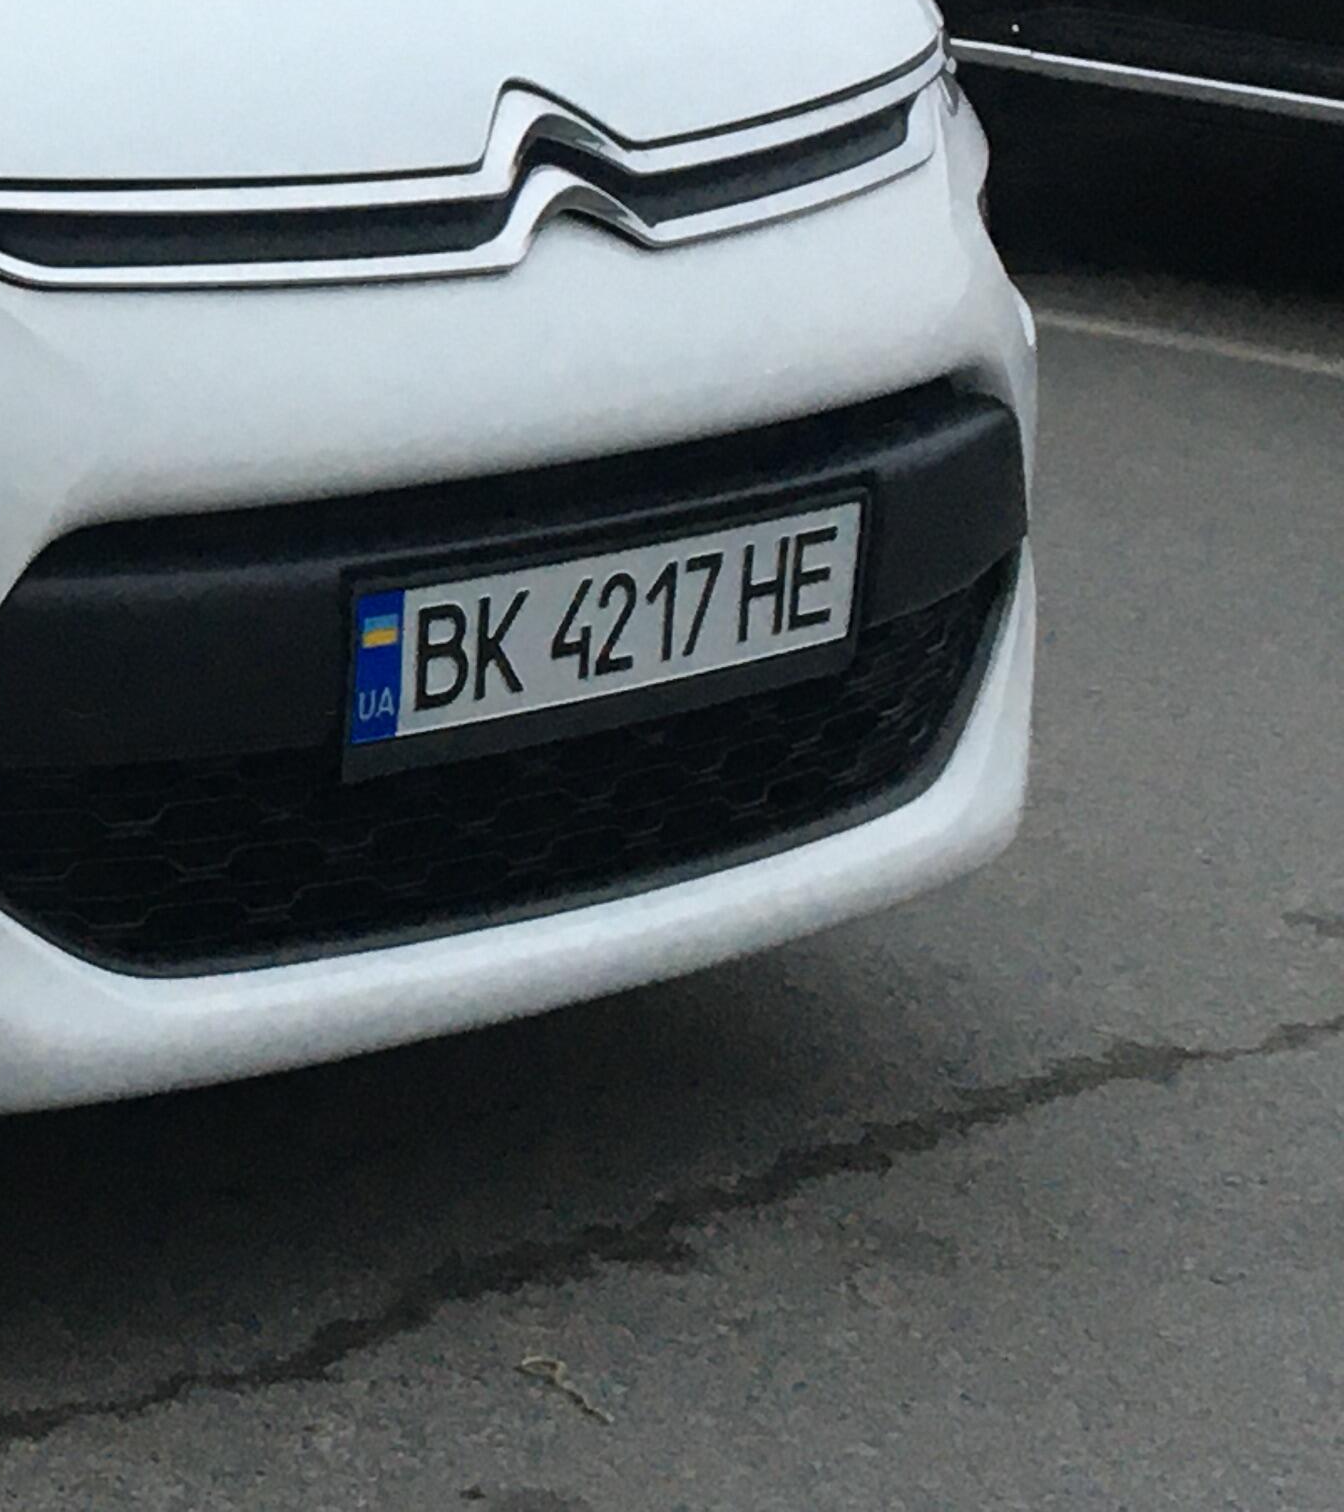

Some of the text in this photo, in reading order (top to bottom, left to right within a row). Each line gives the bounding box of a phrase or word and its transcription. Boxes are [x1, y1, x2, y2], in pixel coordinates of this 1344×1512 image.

[413, 525, 839, 712] BK 4217 HE
[358, 690, 396, 721] UA
